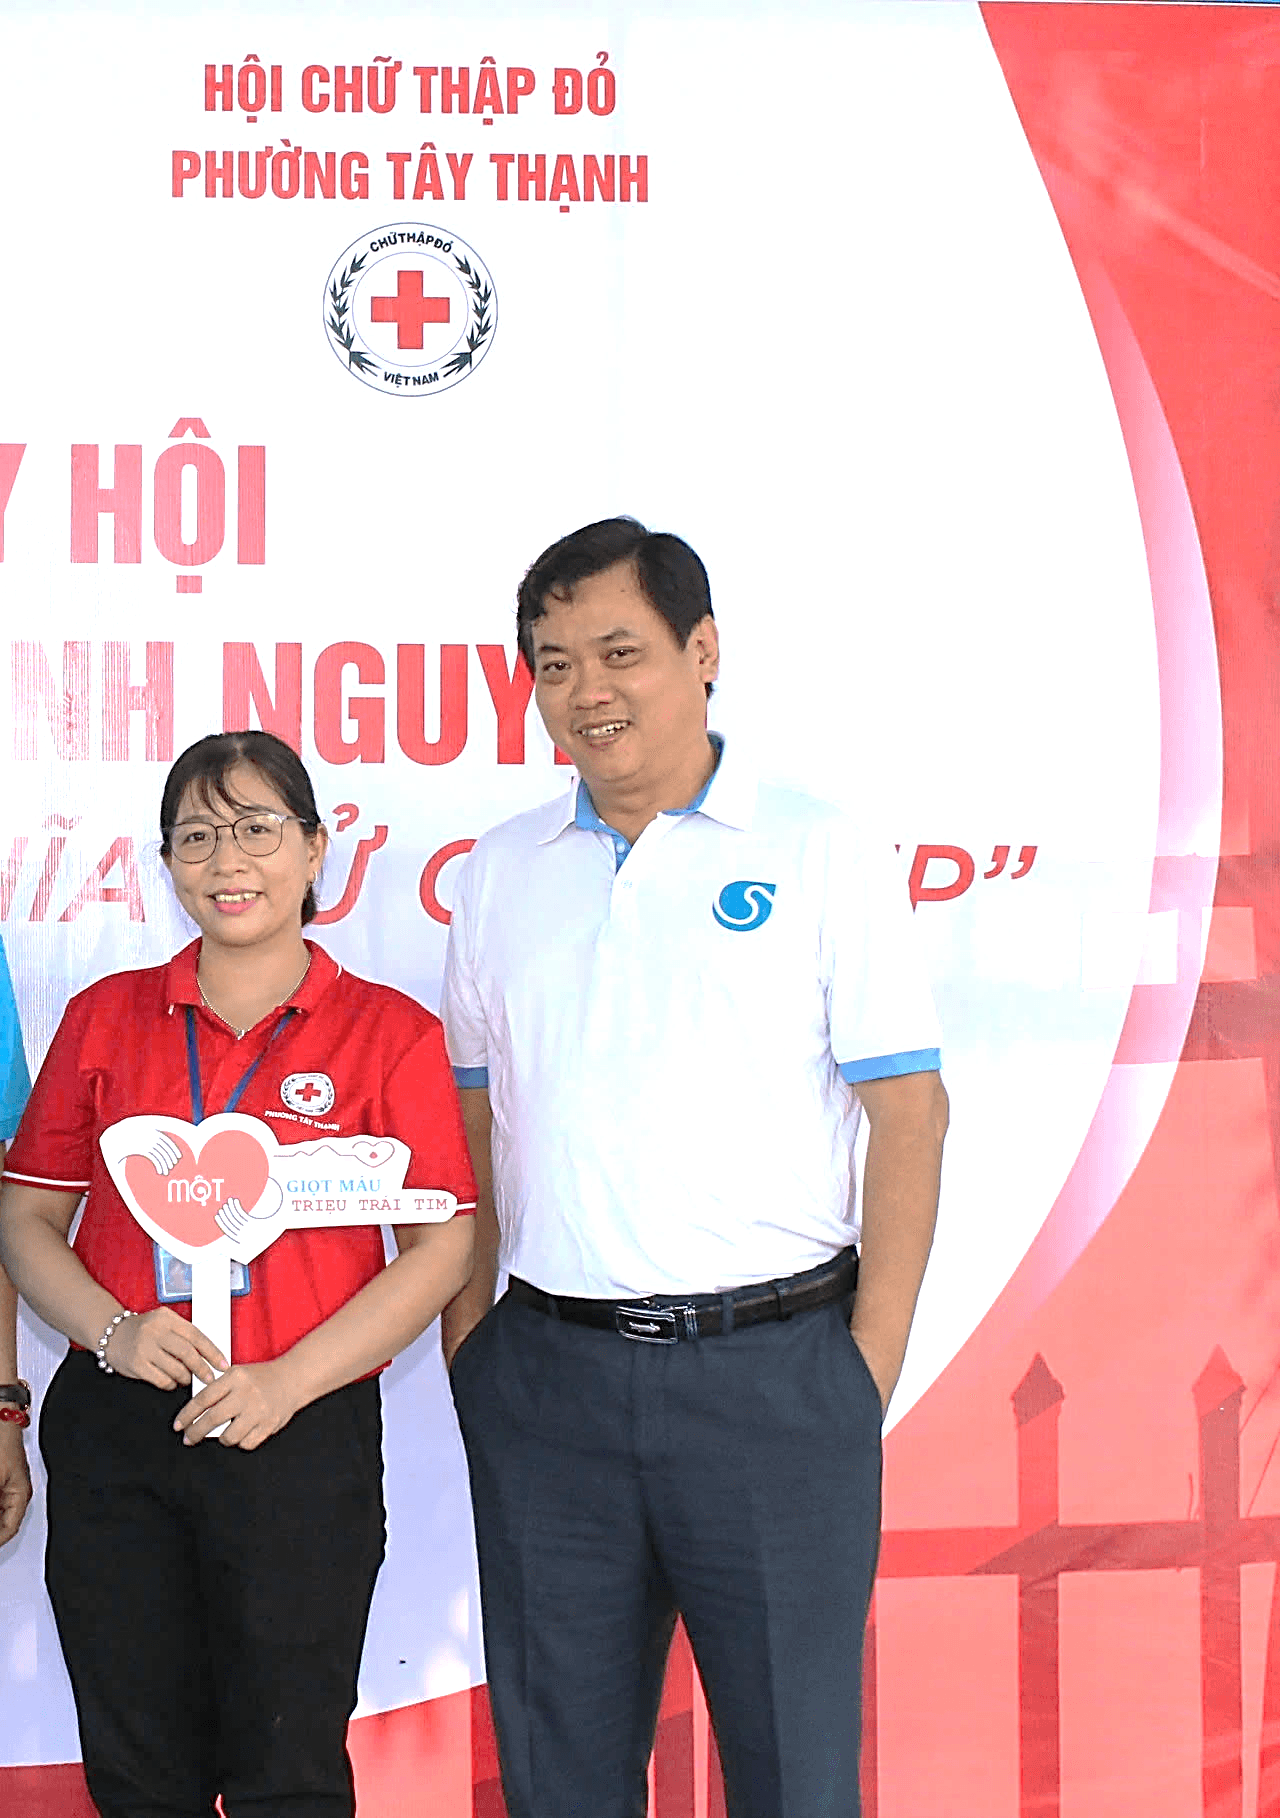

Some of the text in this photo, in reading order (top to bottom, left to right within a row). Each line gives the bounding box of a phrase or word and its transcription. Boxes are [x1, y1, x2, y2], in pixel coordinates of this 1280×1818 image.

[204, 51, 616, 125] HỘI CHỮ THẬP ĐỎ
[172, 139, 649, 213] PHƯỜNG TÂY THẠNH
[383, 371, 440, 388] VIỆT NAM
[70, 417, 267, 594] HỘI
[222, 640, 577, 767] NGUY
[298, 1115, 314, 1126] TÂY
[286, 1176, 381, 1196] GIỌT MÁU
[359, 1195, 401, 1211] TRÁI
[414, 1198, 448, 1210] TIM
